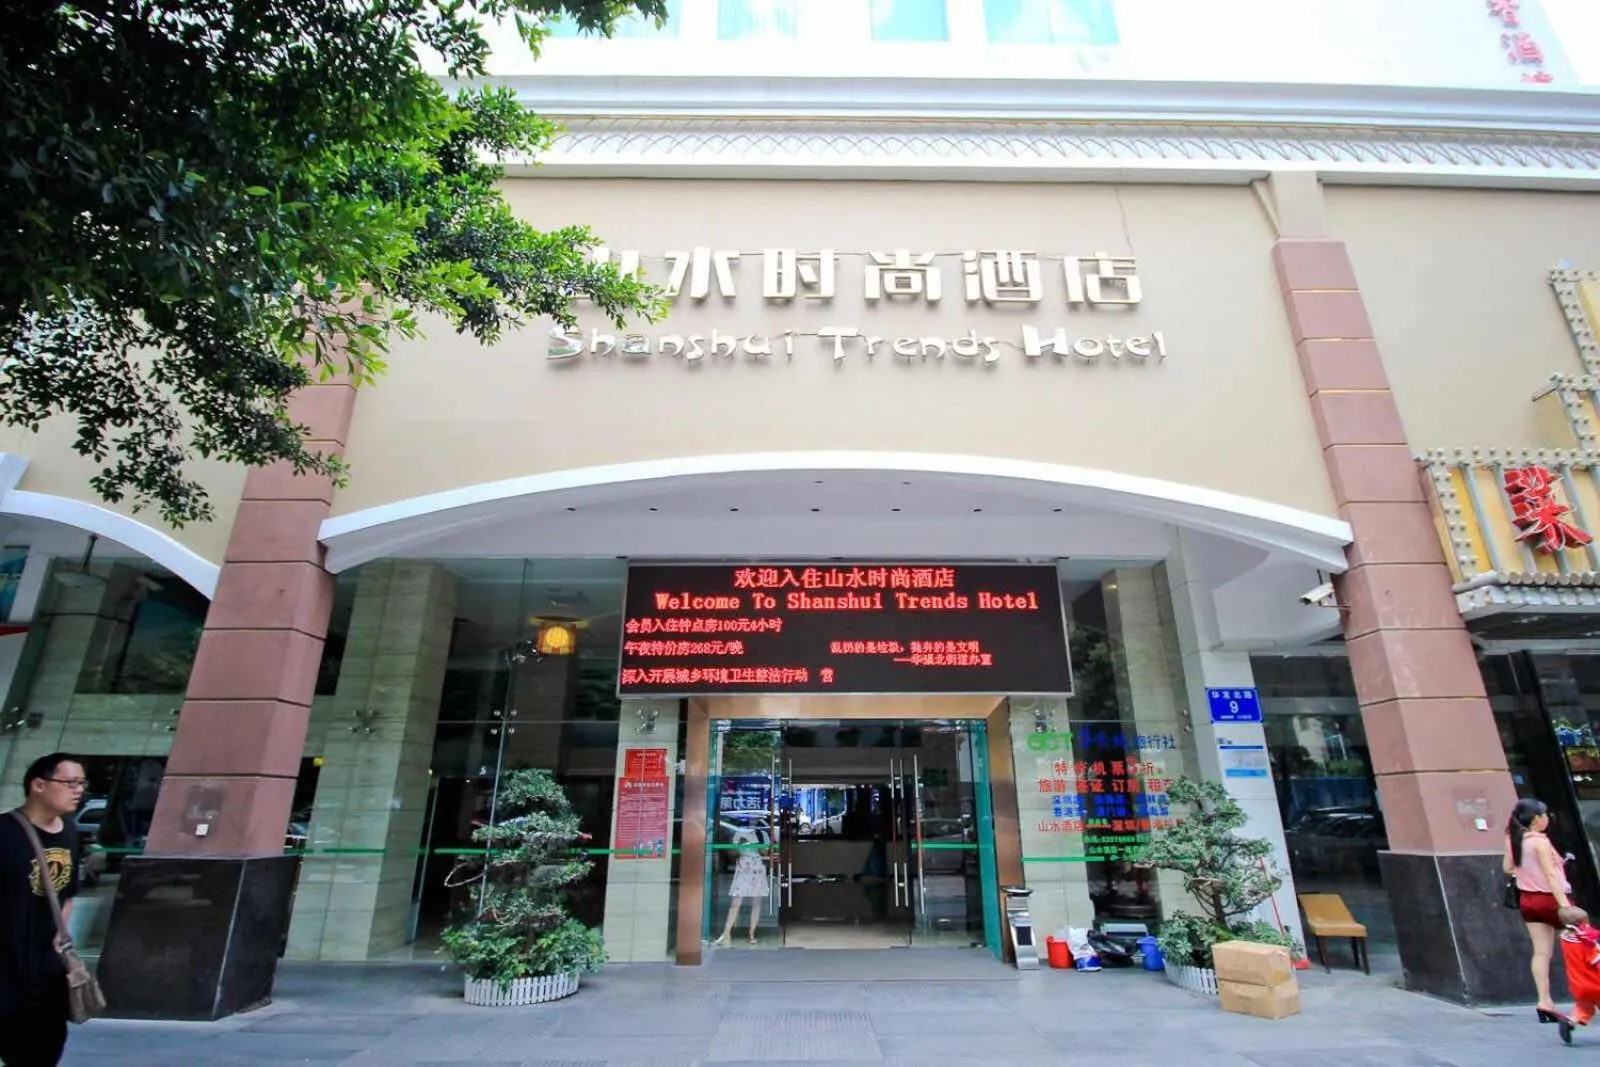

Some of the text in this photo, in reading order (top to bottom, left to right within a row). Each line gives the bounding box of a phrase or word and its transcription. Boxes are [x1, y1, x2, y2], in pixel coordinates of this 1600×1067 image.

[547, 324, 1167, 363] Shanshui Trends Hotel
[734, 568, 954, 588] 欢迎入住山水时尚酒店
[655, 592, 1039, 610] Welcome To Shanshui Trends Hotel
[1229, 700, 1239, 714] 9
